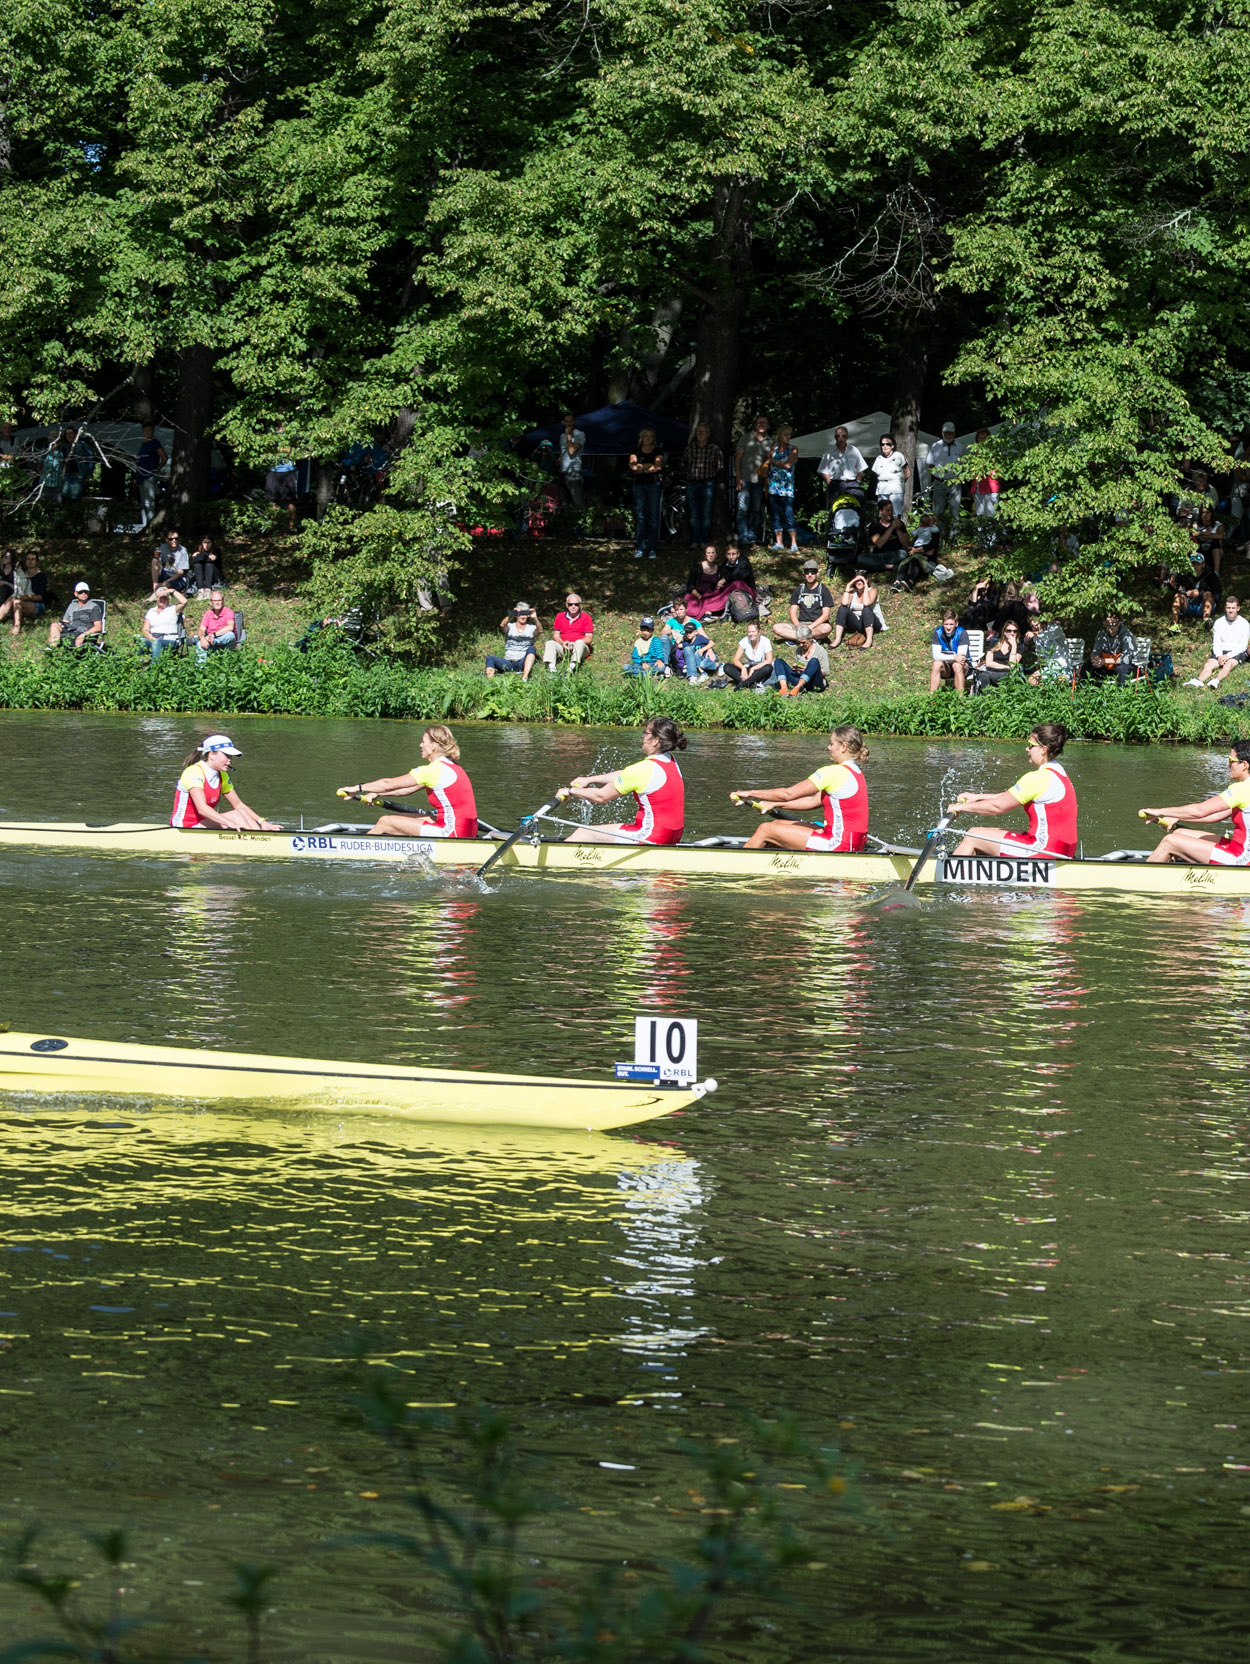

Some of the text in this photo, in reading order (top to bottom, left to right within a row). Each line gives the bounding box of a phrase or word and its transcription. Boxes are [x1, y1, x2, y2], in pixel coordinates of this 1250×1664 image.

[218, 833, 237, 841] Bessel
[308, 837, 433, 853] RBL RUDER-BUNDESLIGA
[571, 845, 602, 862] Melitta
[768, 852, 800, 869] Melitta
[944, 859, 1049, 883] MINDEN
[1182, 867, 1216, 884] Melitta
[650, 1021, 686, 1064] 10
[673, 1069, 693, 1077] RBL
